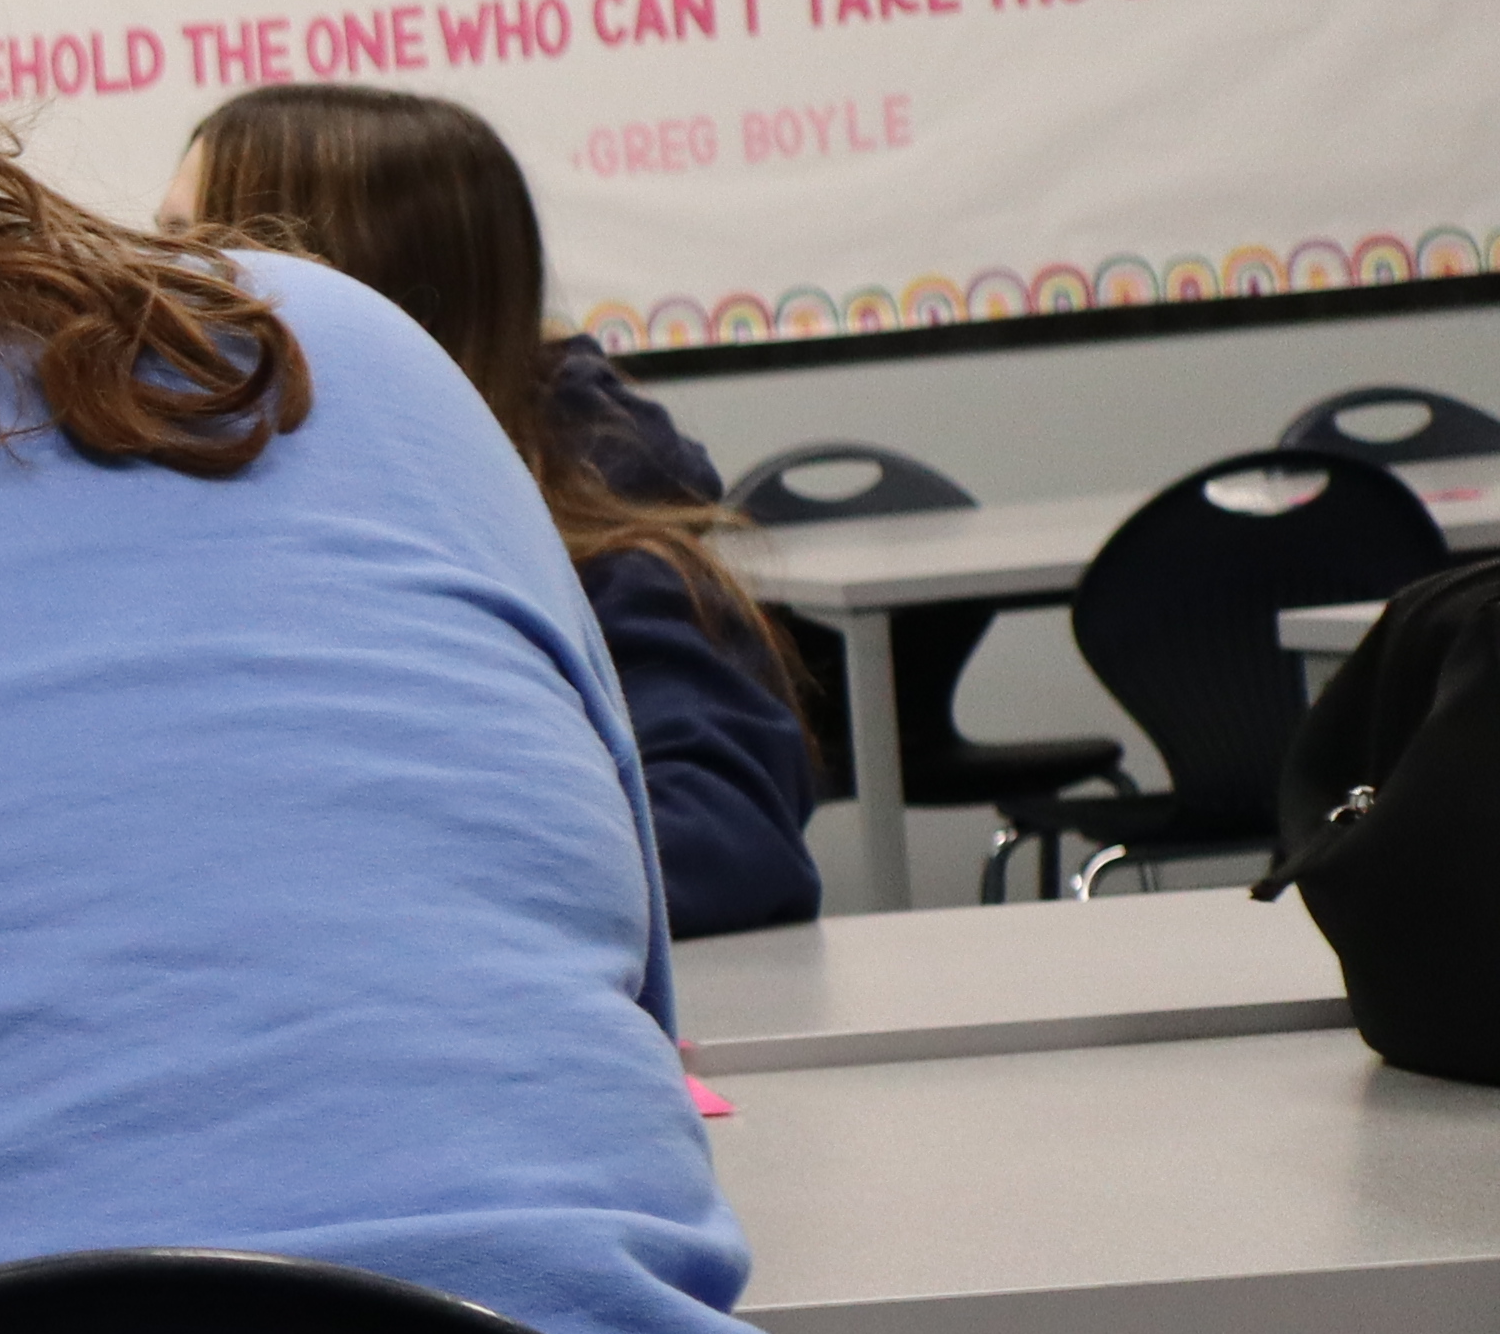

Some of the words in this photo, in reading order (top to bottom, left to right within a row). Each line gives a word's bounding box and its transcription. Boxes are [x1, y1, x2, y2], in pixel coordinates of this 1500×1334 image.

[182, 18, 293, 86] THE
[305, 5, 427, 81] ONE
[742, 95, 912, 164] BOYLE
